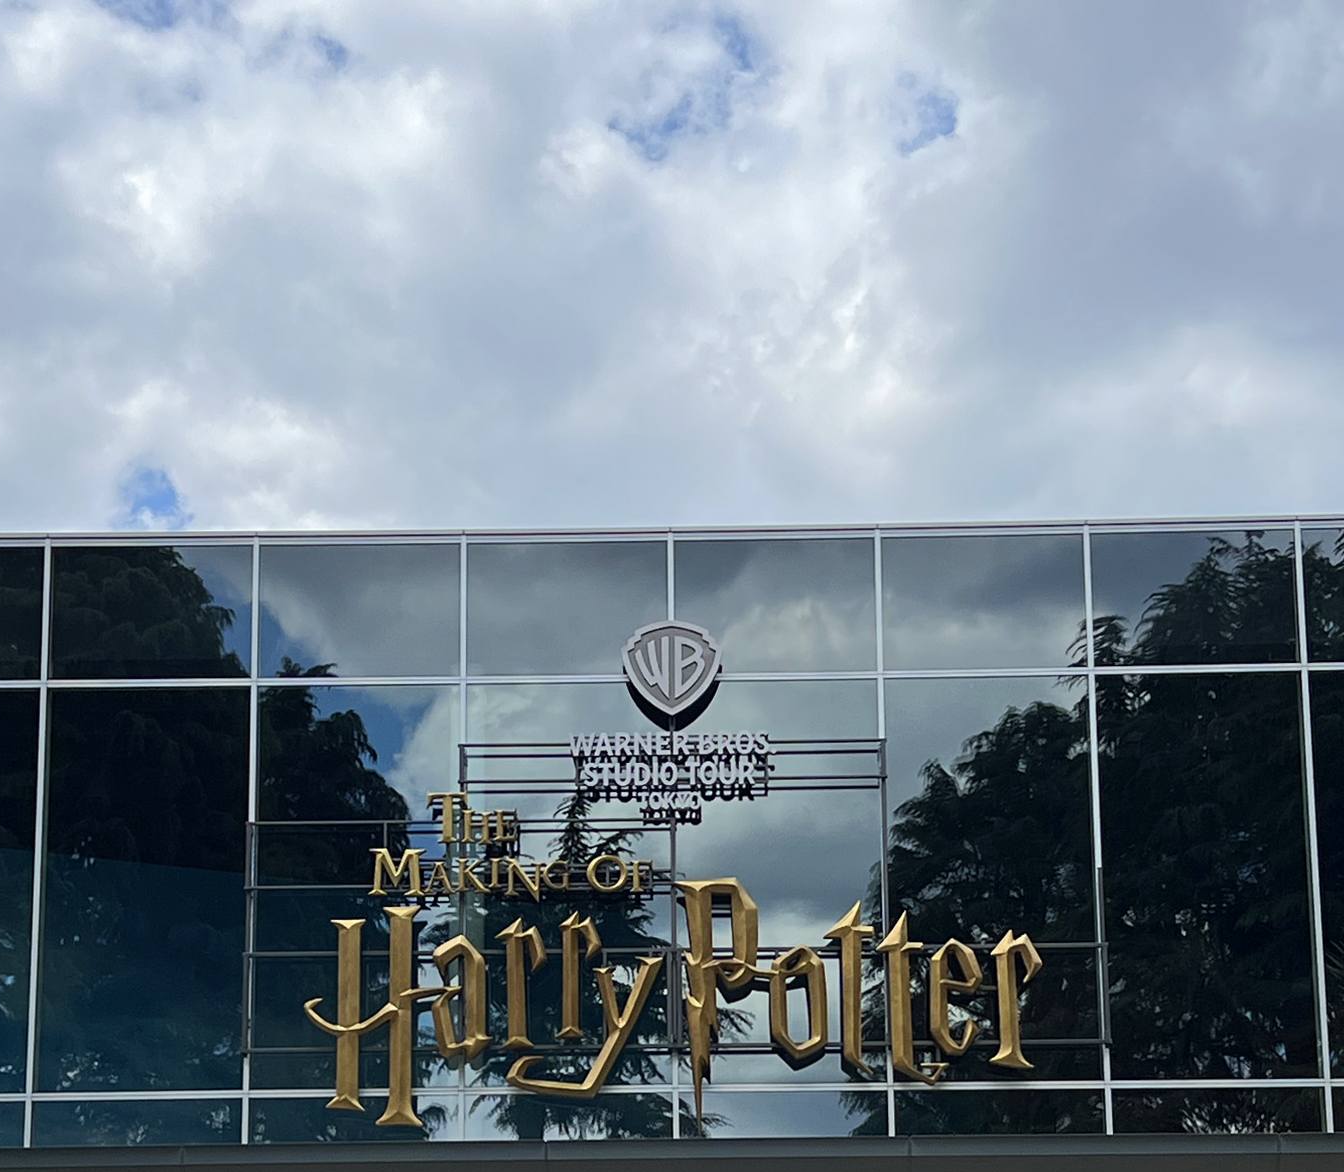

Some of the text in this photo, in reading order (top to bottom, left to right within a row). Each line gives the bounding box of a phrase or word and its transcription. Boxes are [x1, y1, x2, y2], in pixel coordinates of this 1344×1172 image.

[634, 635, 706, 700] WB
[569, 730, 777, 756] WARNER BROS.
[583, 758, 755, 787] STUDIO TOUR
[640, 791, 702, 810] TOKYO
[304, 876, 1043, 1138] Harry Potter
